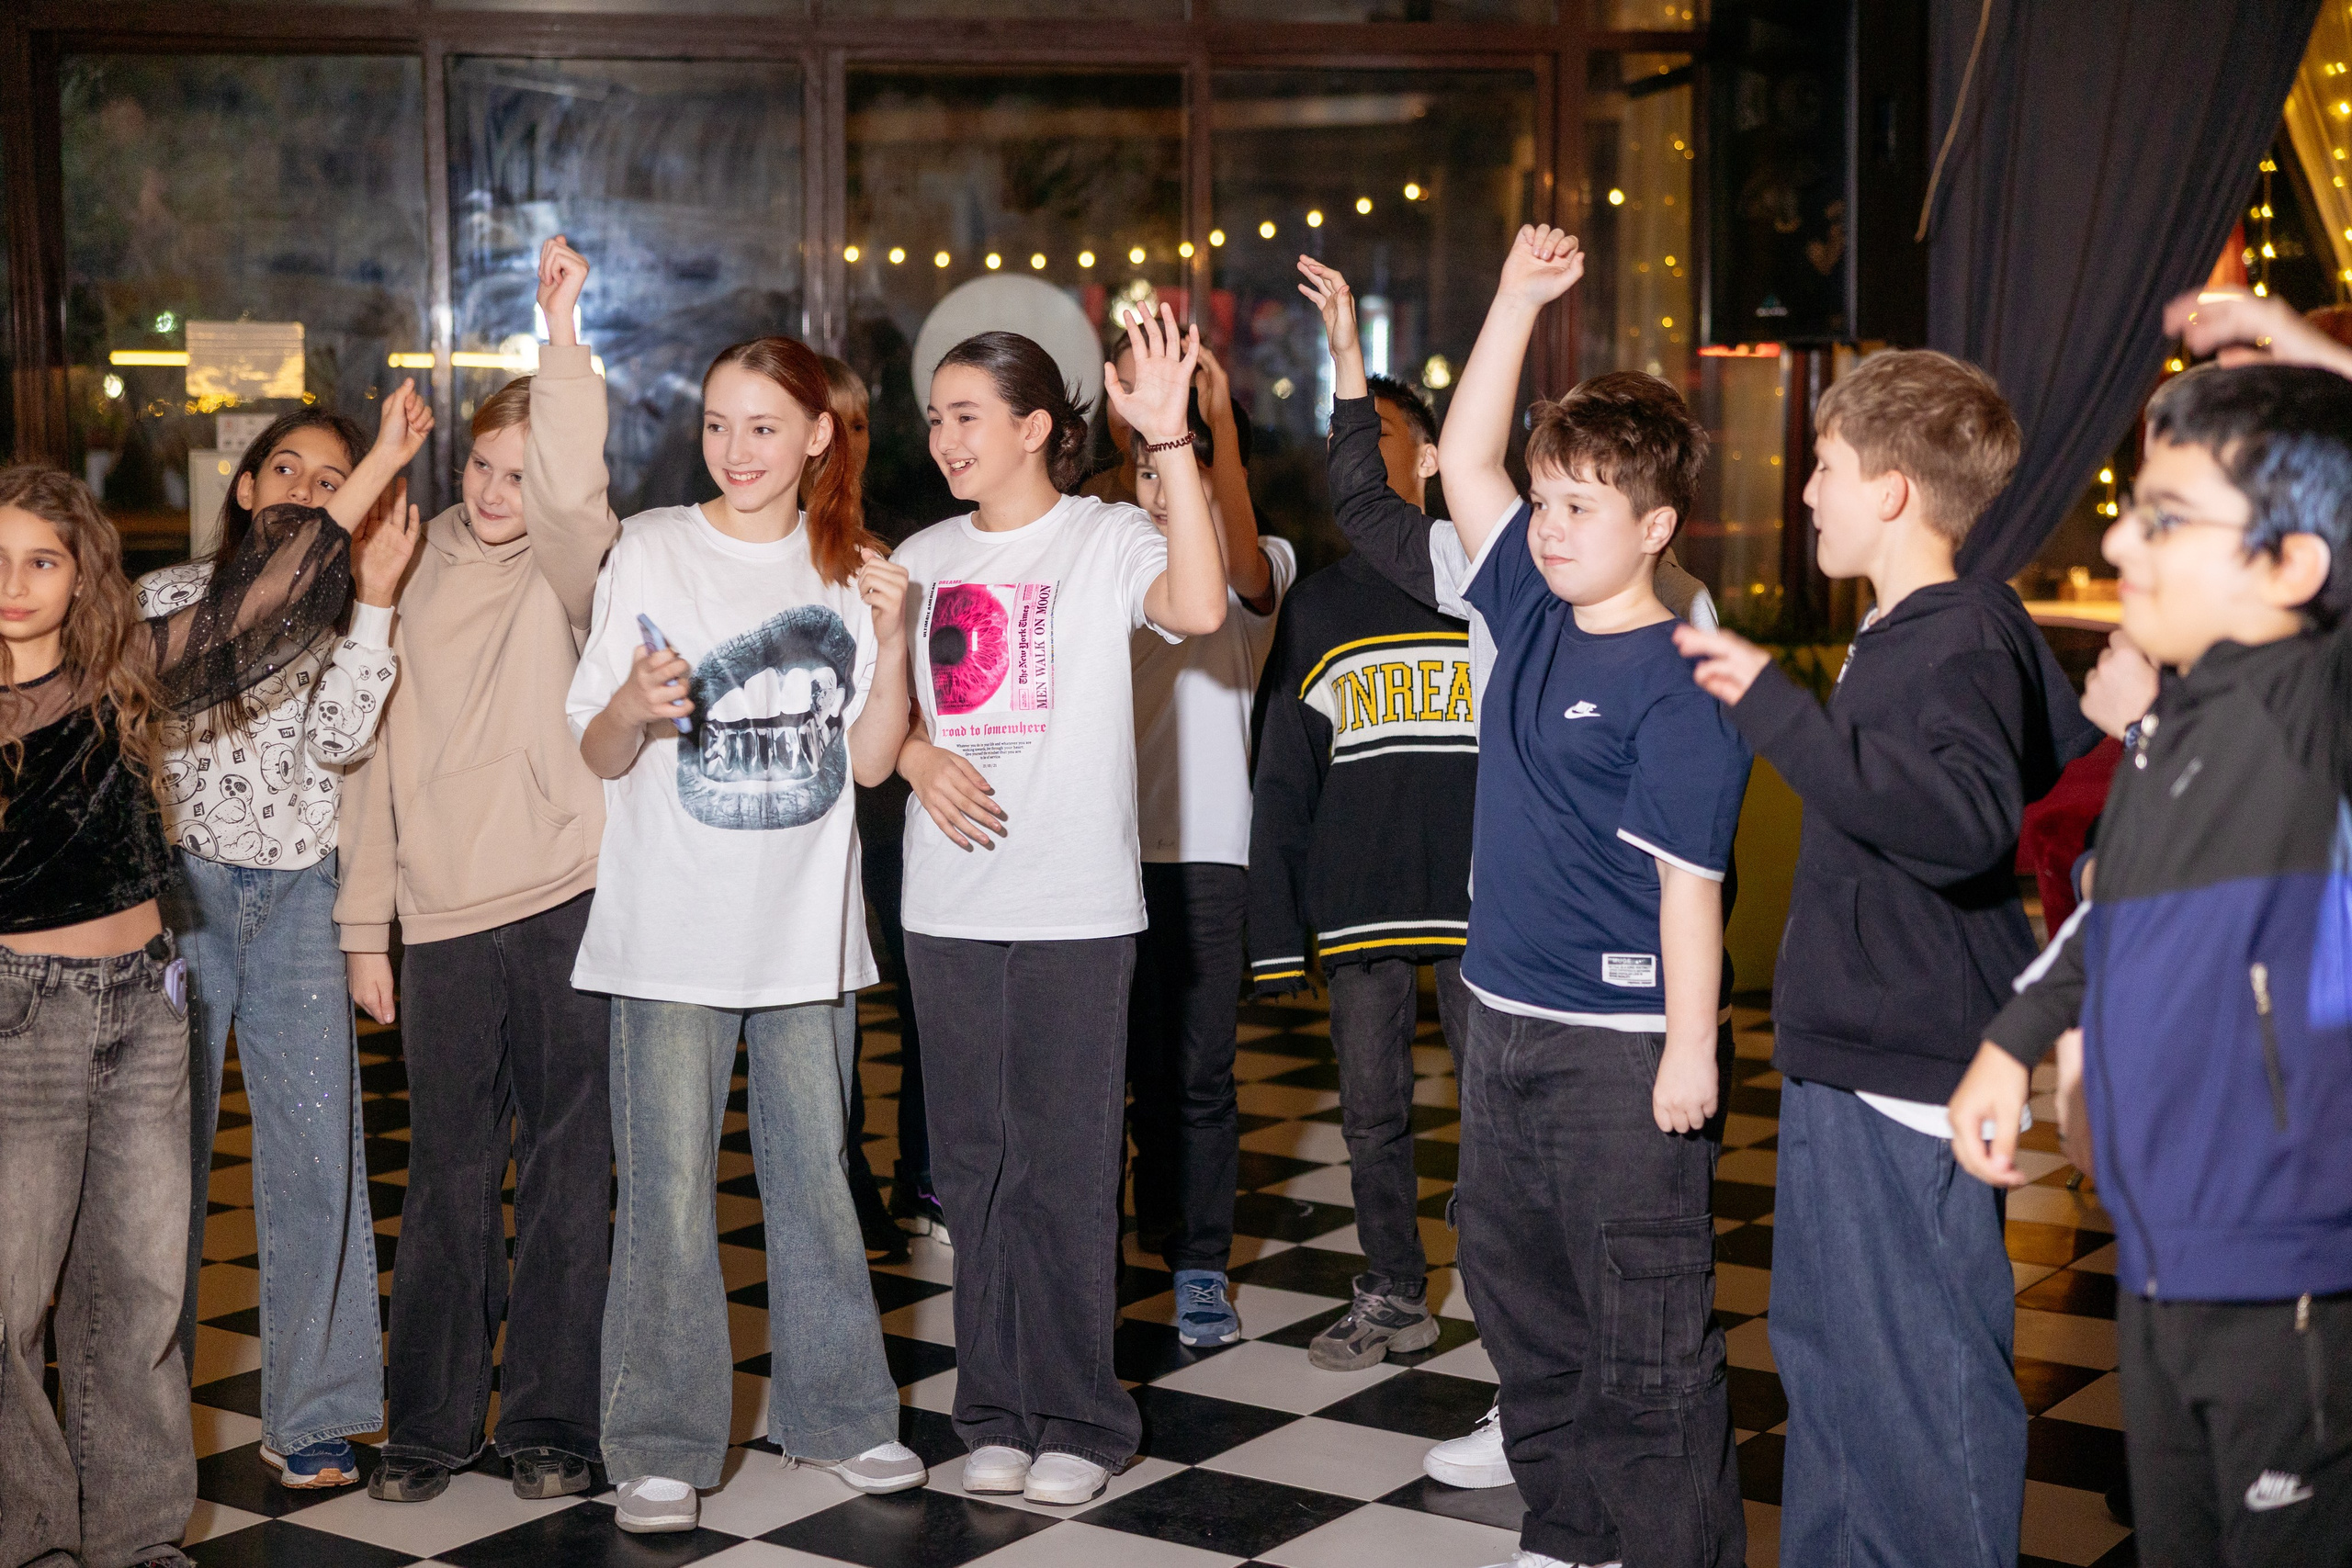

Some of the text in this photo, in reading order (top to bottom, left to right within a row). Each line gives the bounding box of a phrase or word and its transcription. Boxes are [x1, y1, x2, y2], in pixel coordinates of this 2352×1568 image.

[927, 582, 936, 610] AMERICAN
[1018, 604, 1030, 627] Times
[1018, 628, 1029, 649] York
[1034, 584, 1051, 709] MEN WALK ON MOON
[1018, 650, 1028, 668] New
[1018, 670, 1028, 684] The
[942, 726, 967, 737] road
[970, 725, 980, 736] to
